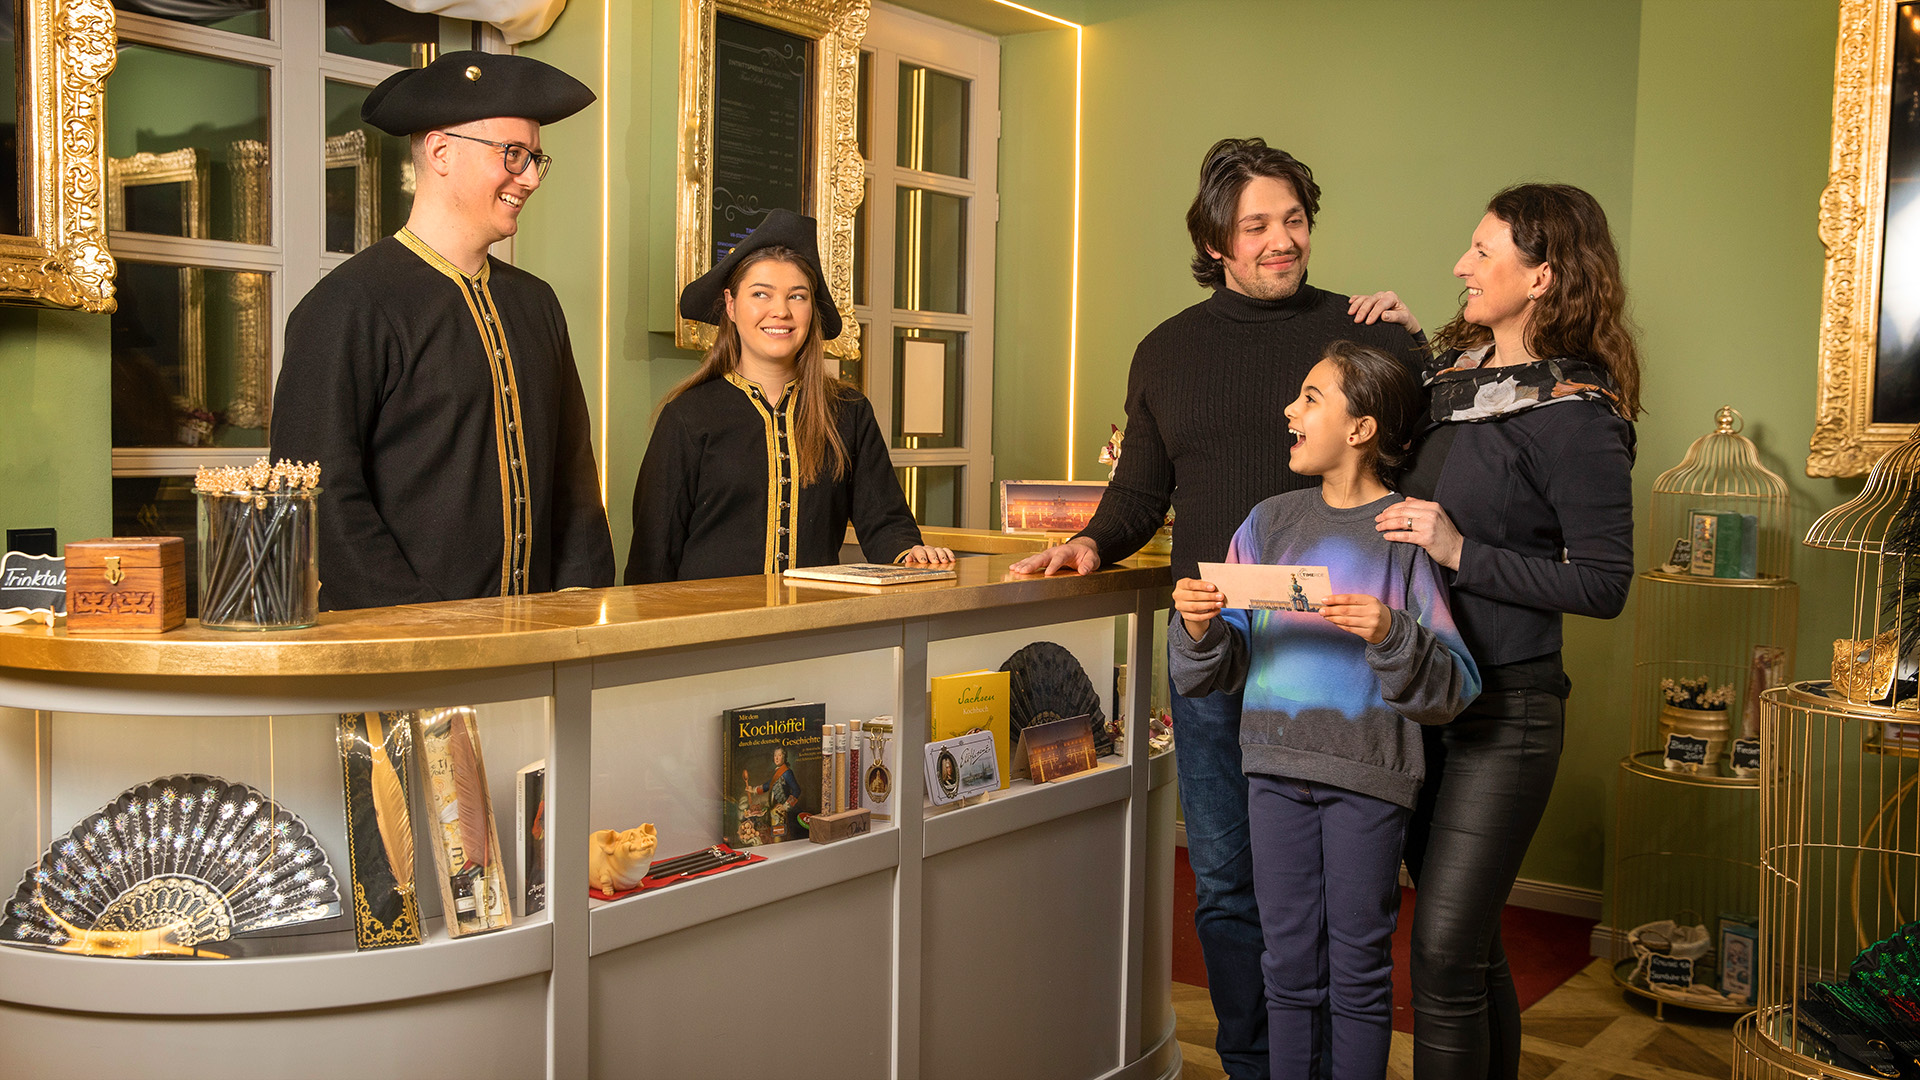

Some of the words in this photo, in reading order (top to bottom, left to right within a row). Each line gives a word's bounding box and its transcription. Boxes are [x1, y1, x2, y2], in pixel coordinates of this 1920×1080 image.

[957, 686, 995, 705] Sachsen
[738, 716, 806, 738] Kochlöffel
[781, 735, 821, 747] Geschichte
